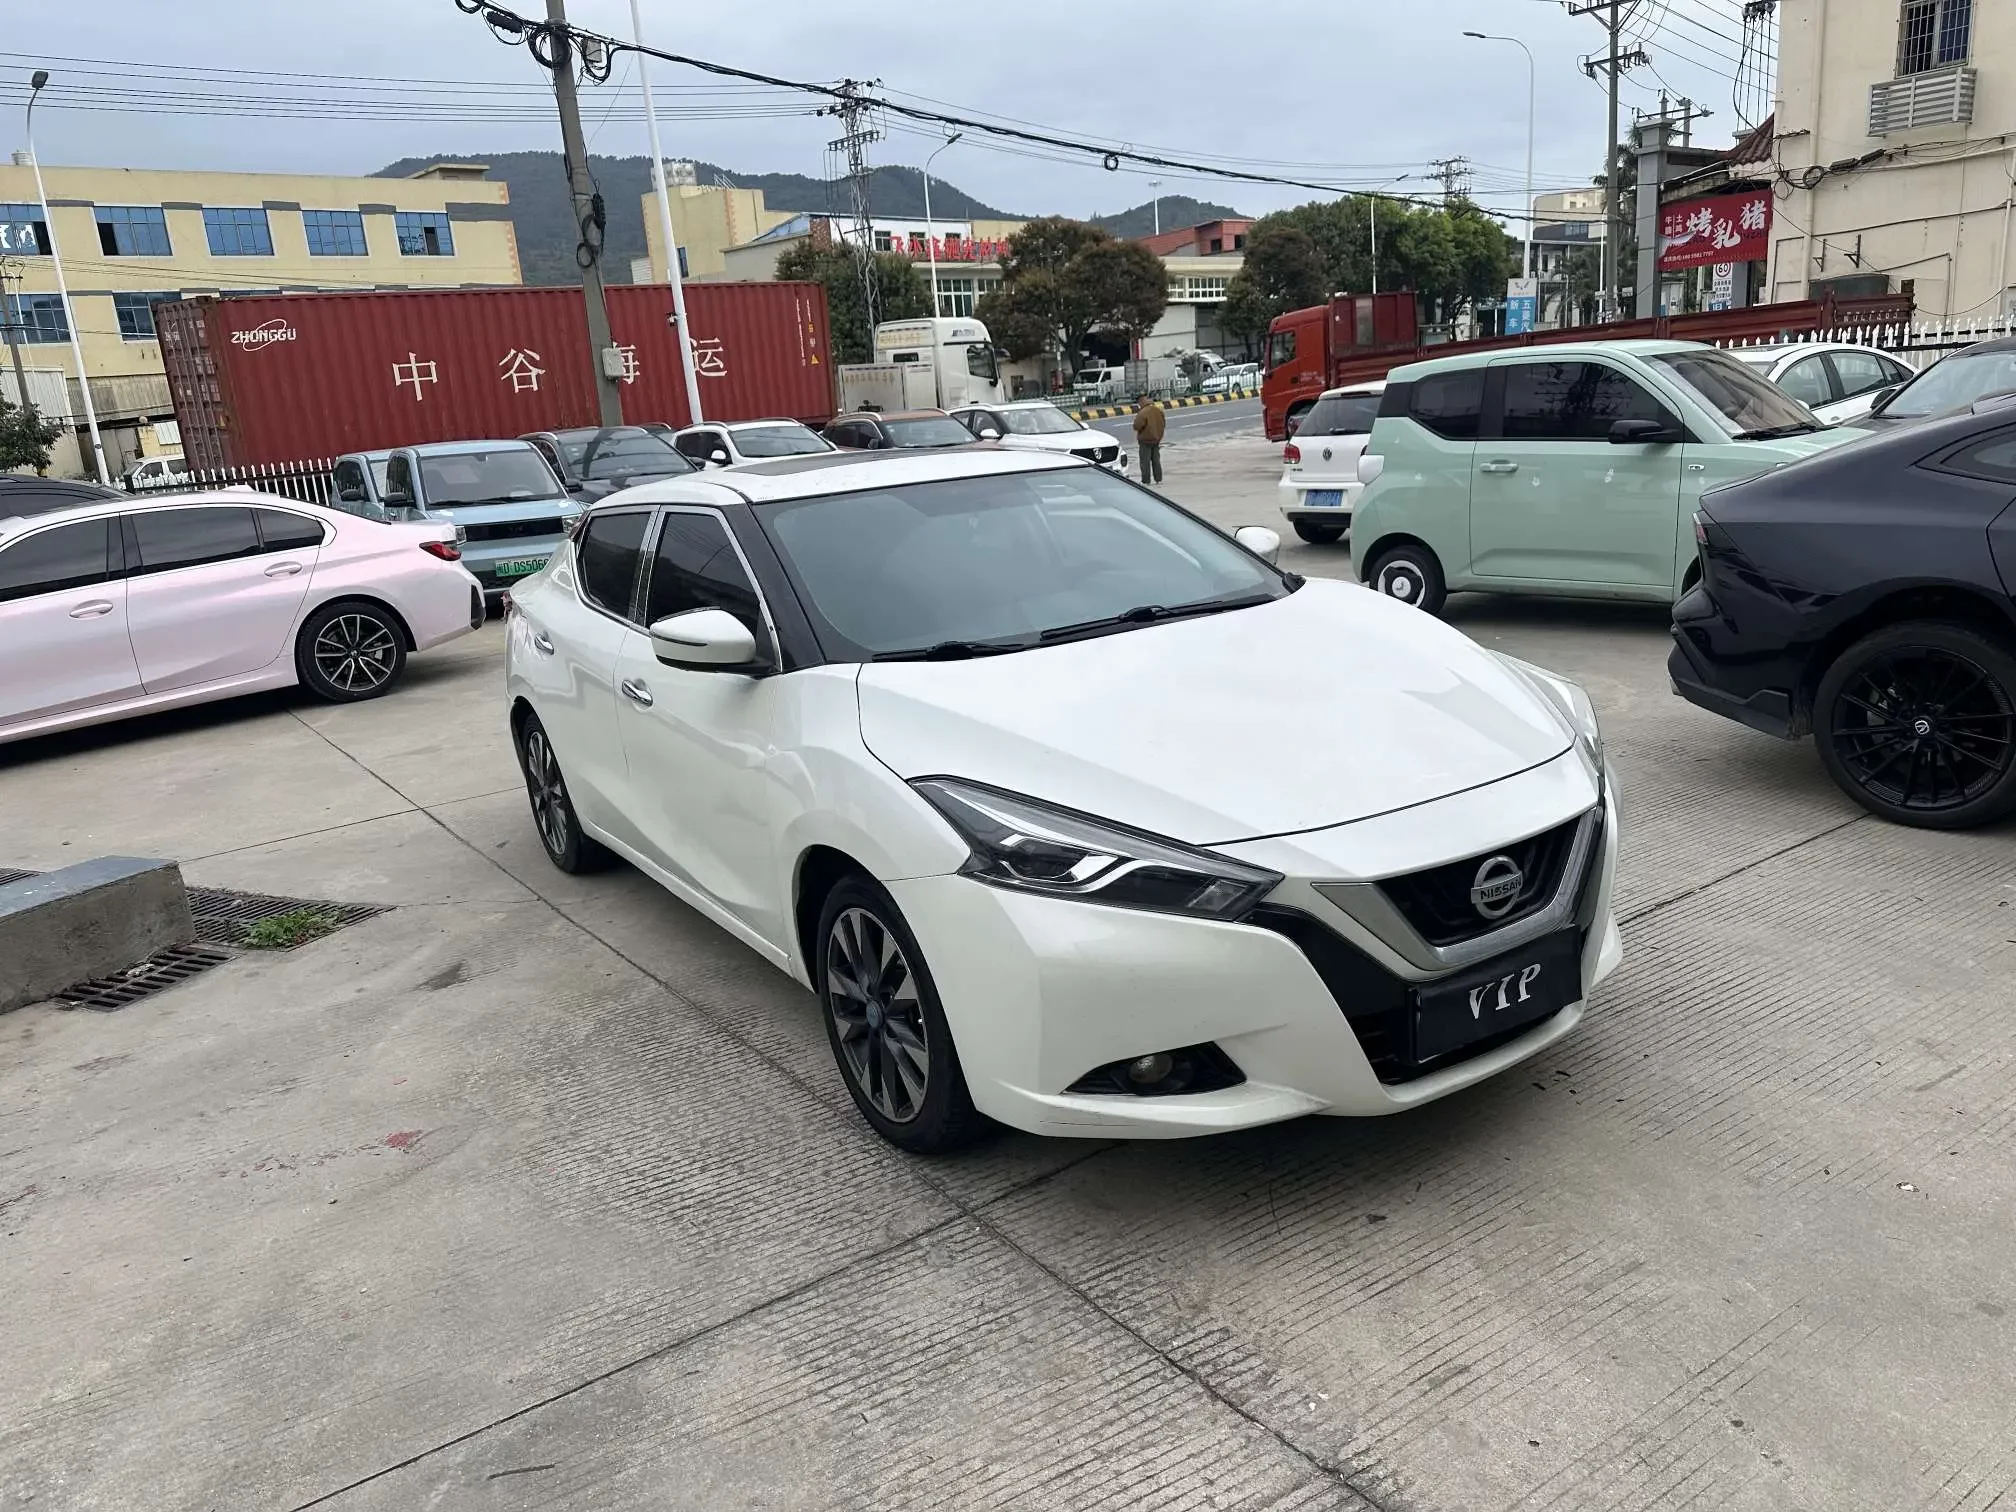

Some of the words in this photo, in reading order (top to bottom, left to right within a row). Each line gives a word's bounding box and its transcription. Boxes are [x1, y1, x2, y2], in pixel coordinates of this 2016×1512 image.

[1686, 200, 1767, 249] 烤乳猪
[1719, 263, 1728, 273] 60
[231, 328, 296, 344] ZHONGGU
[1480, 879, 1521, 900] NISSAN
[1469, 963, 1541, 1020] VIP
